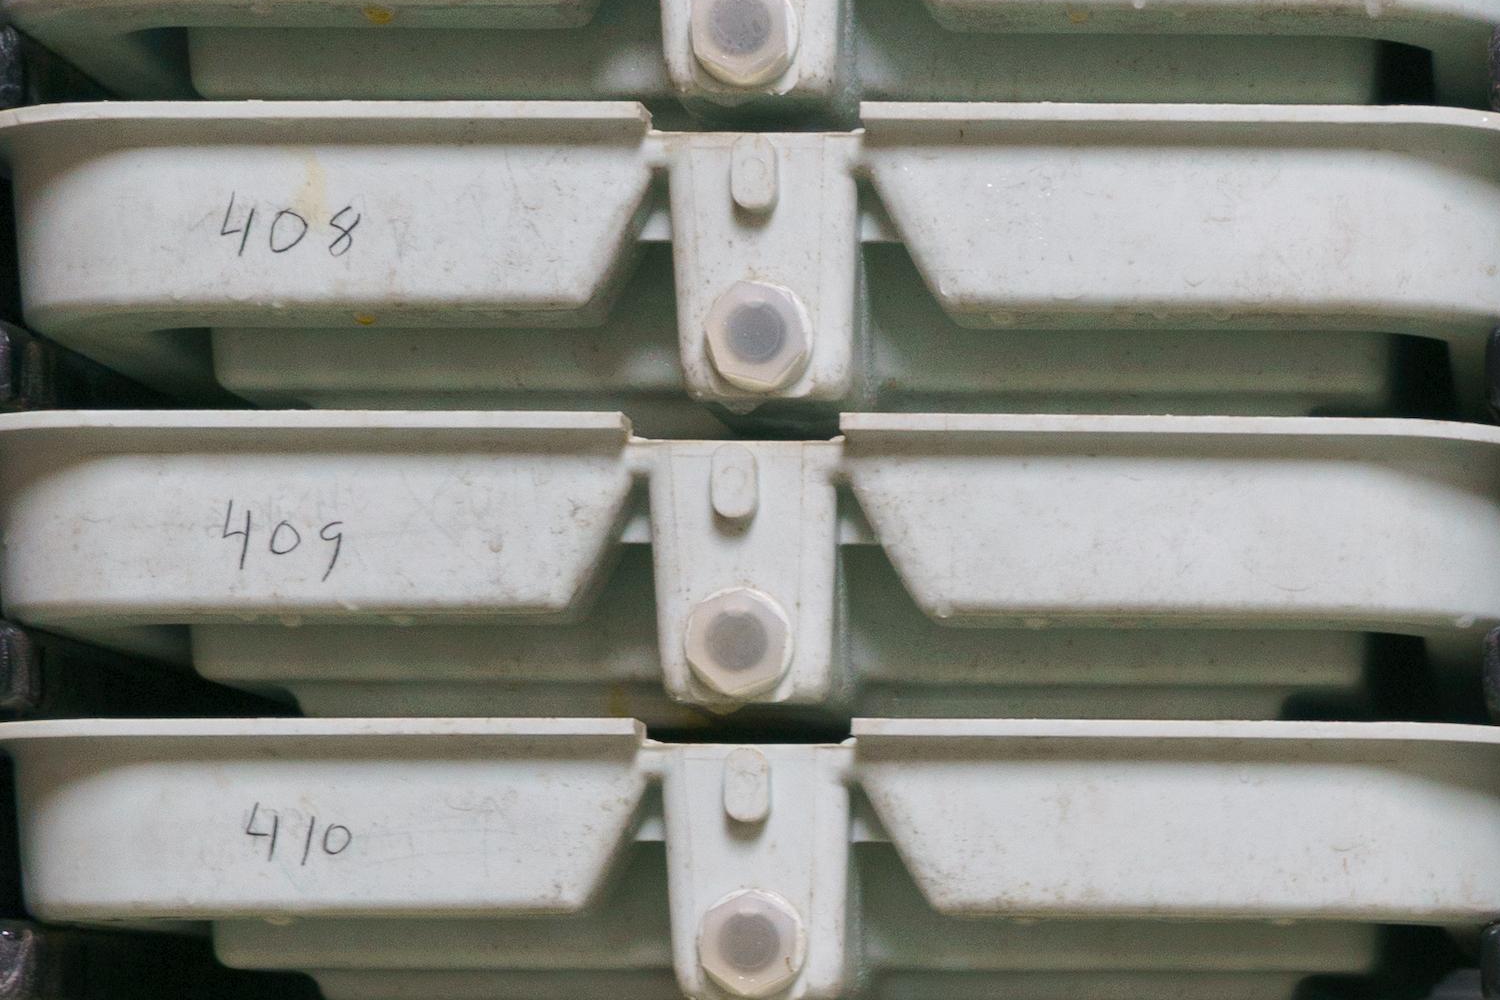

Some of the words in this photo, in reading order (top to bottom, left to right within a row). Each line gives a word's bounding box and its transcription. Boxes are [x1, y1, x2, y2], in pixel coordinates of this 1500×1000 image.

[219, 196, 361, 257] 408
[222, 500, 344, 580] 409
[244, 802, 353, 866] 410
